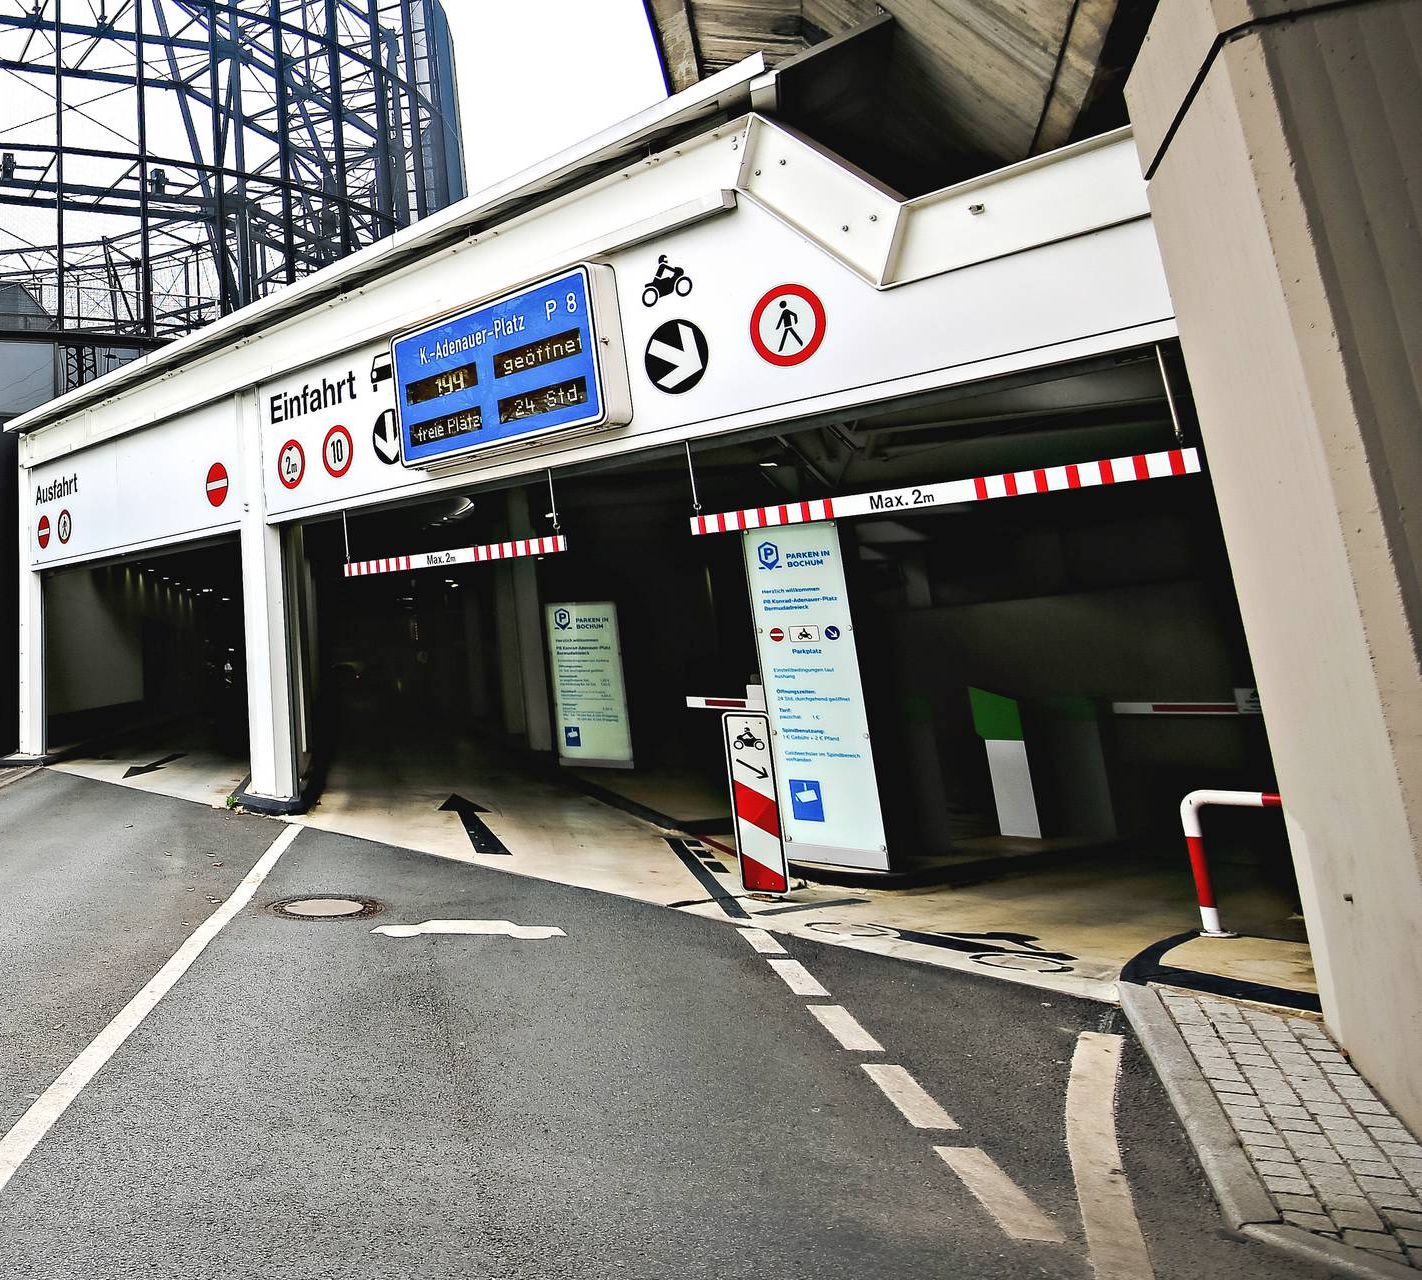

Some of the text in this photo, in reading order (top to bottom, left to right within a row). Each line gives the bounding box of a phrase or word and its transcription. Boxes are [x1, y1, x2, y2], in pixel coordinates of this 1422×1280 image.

[419, 292, 578, 365] K.-Adenauer-Platz P 8
[270, 370, 357, 425] Einfahrt
[513, 384, 584, 417] 24 Std.
[417, 412, 483, 442] freie Plätz
[331, 439, 344, 464] 10
[286, 456, 298, 475] 2m
[35, 473, 78, 506] Ausfahrt
[869, 489, 935, 510] Max. 2m
[426, 552, 457, 565] Max. 2m
[786, 550, 831, 560] PARKEN IN
[787, 559, 824, 568] BOCHUM
